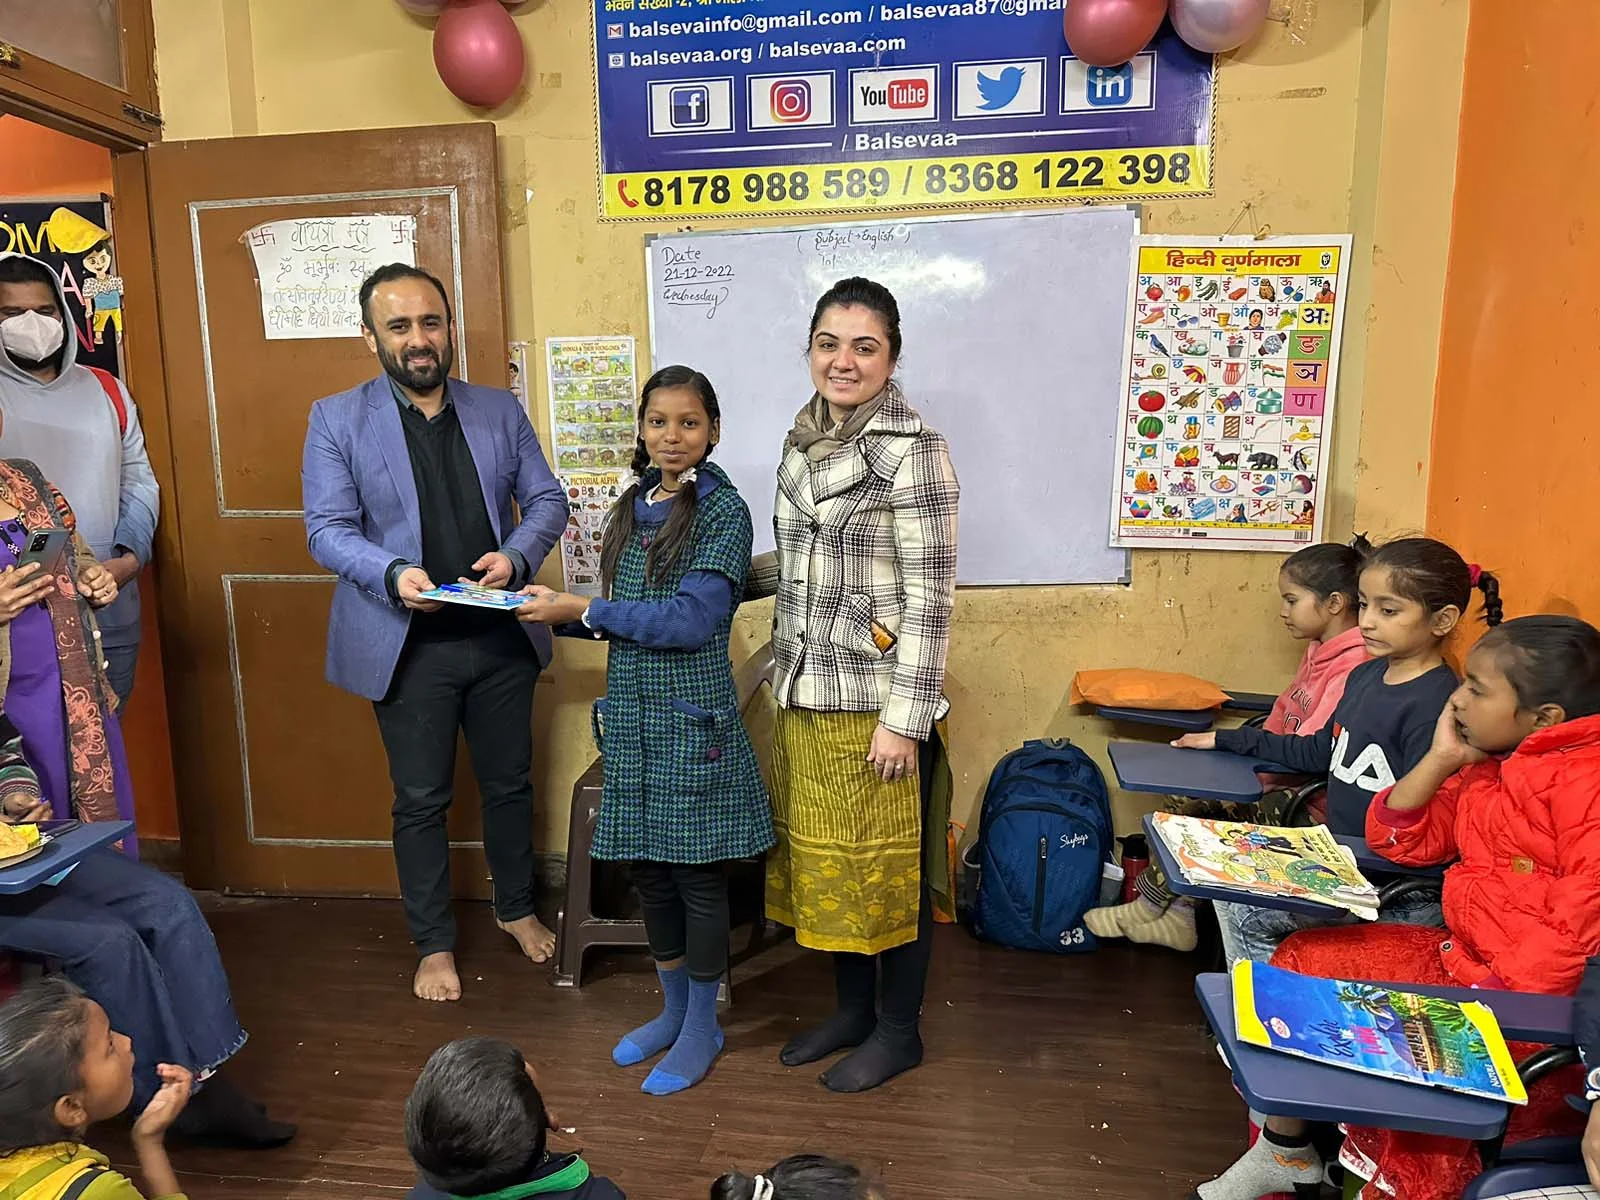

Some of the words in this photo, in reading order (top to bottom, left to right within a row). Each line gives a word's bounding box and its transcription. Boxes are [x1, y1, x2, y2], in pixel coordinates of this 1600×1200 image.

[629, 10, 862, 38] balsevainfo@gmail.com
[880, 0, 1067, 21] balsevaa87@gmai
[630, 46, 752, 67] balsevaa.org
[769, 37, 906, 58] balsevaa.com
[860, 83, 926, 106] YouTube
[855, 131, 958, 151] Balsevaa
[644, 174, 731, 207] 8178
[743, 171, 809, 203] 988
[823, 167, 890, 199] 589
[925, 161, 1018, 194] 8368
[1033, 156, 1104, 189] 122
[1118, 153, 1190, 185] 398
[661, 245, 701, 266] Date
[1166, 249, 1217, 267] हिन्दी
[1221, 250, 1302, 267] वर्णमाला
[664, 264, 735, 281] 21-12-2022
[1140, 276, 1152, 285] अ
[1167, 276, 1182, 286] आ
[1194, 276, 1204, 289] इ
[1223, 277, 1231, 293] ई
[1250, 277, 1261, 286] उ
[1280, 277, 1293, 287] ऊ
[1309, 276, 1324, 287] ऋ
[1138, 303, 1148, 316] ए
[1169, 303, 1180, 321] ऐ
[1202, 304, 1217, 318] ओ
[1233, 302, 1249, 318] औ
[1266, 302, 1280, 317] अं
[1301, 308, 1330, 325] अः
[1136, 331, 1150, 340] क
[1174, 331, 1187, 341] ख
[1213, 331, 1223, 340] ग
[1253, 331, 1263, 341] घ
[1296, 335, 1323, 354] ङ
[1133, 359, 1145, 368] च
[1172, 358, 1184, 369] छ
[1210, 359, 1222, 369] ज
[1250, 359, 1262, 371] झ
[1293, 363, 1322, 382] ञ
[1131, 386, 1141, 396] ट
[1170, 387, 1180, 397] ठ
[1208, 387, 1218, 398] ड
[1247, 387, 1257, 397] ढ
[1292, 393, 1318, 409] ण
[1129, 414, 1139, 424] त
[1167, 414, 1177, 424] थ
[1206, 415, 1216, 426] द
[1245, 415, 1256, 425] ध
[1284, 416, 1294, 426] न
[1127, 442, 1136, 452] प
[1166, 443, 1179, 452] फ
[1204, 443, 1215, 452] ब
[1243, 443, 1254, 453] भ
[1282, 444, 1292, 453] म
[1125, 469, 1135, 478] य
[1163, 470, 1171, 479] र
[1201, 471, 1214, 480] ल
[1241, 471, 1251, 481] व
[1280, 472, 1293, 482] श
[582, 486, 587, 495] B
[601, 486, 607, 494] C
[1123, 496, 1133, 506] ष
[1155, 496, 1166, 506] स
[1187, 497, 1196, 509] ह
[1218, 498, 1231, 508] क्ष
[1251, 499, 1261, 509] त्र
[1060, 927, 1085, 945] 33
